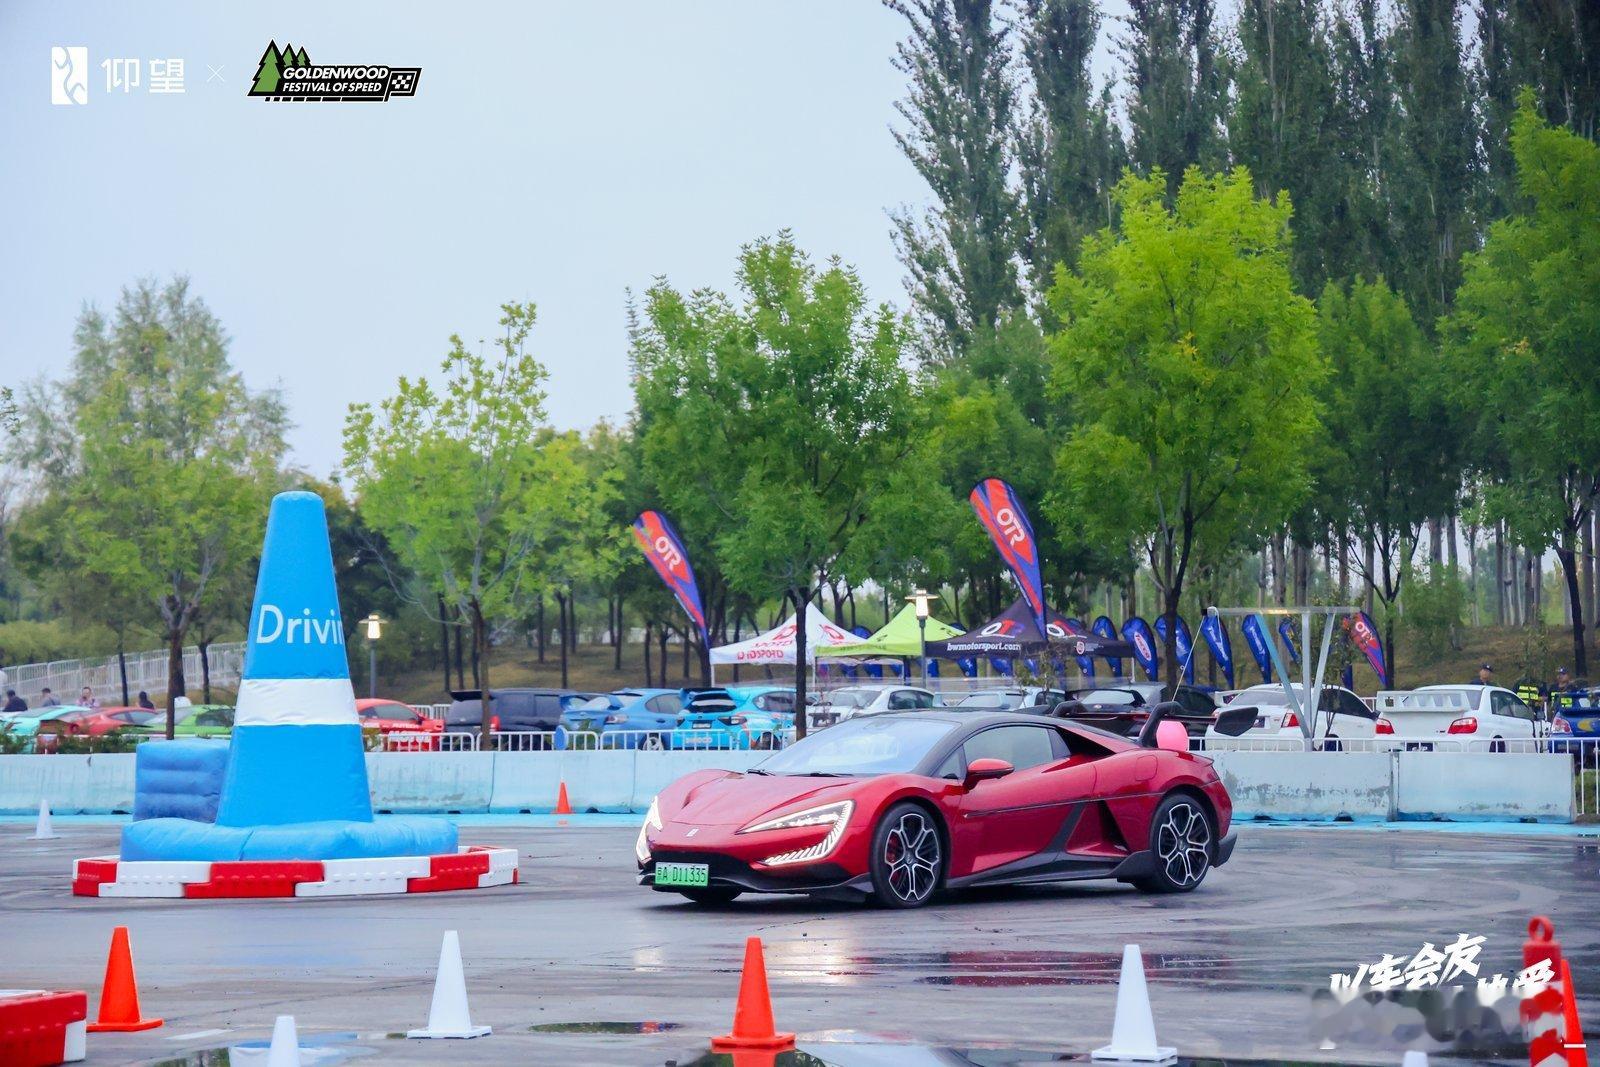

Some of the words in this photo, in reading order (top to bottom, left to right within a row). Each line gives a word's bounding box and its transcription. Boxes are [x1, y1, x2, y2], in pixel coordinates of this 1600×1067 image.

[997, 508, 1026, 547] OTR
[655, 536, 681, 571] OTR
[946, 641, 1022, 652] bwmotorsport.com
[672, 866, 706, 883] D11335
